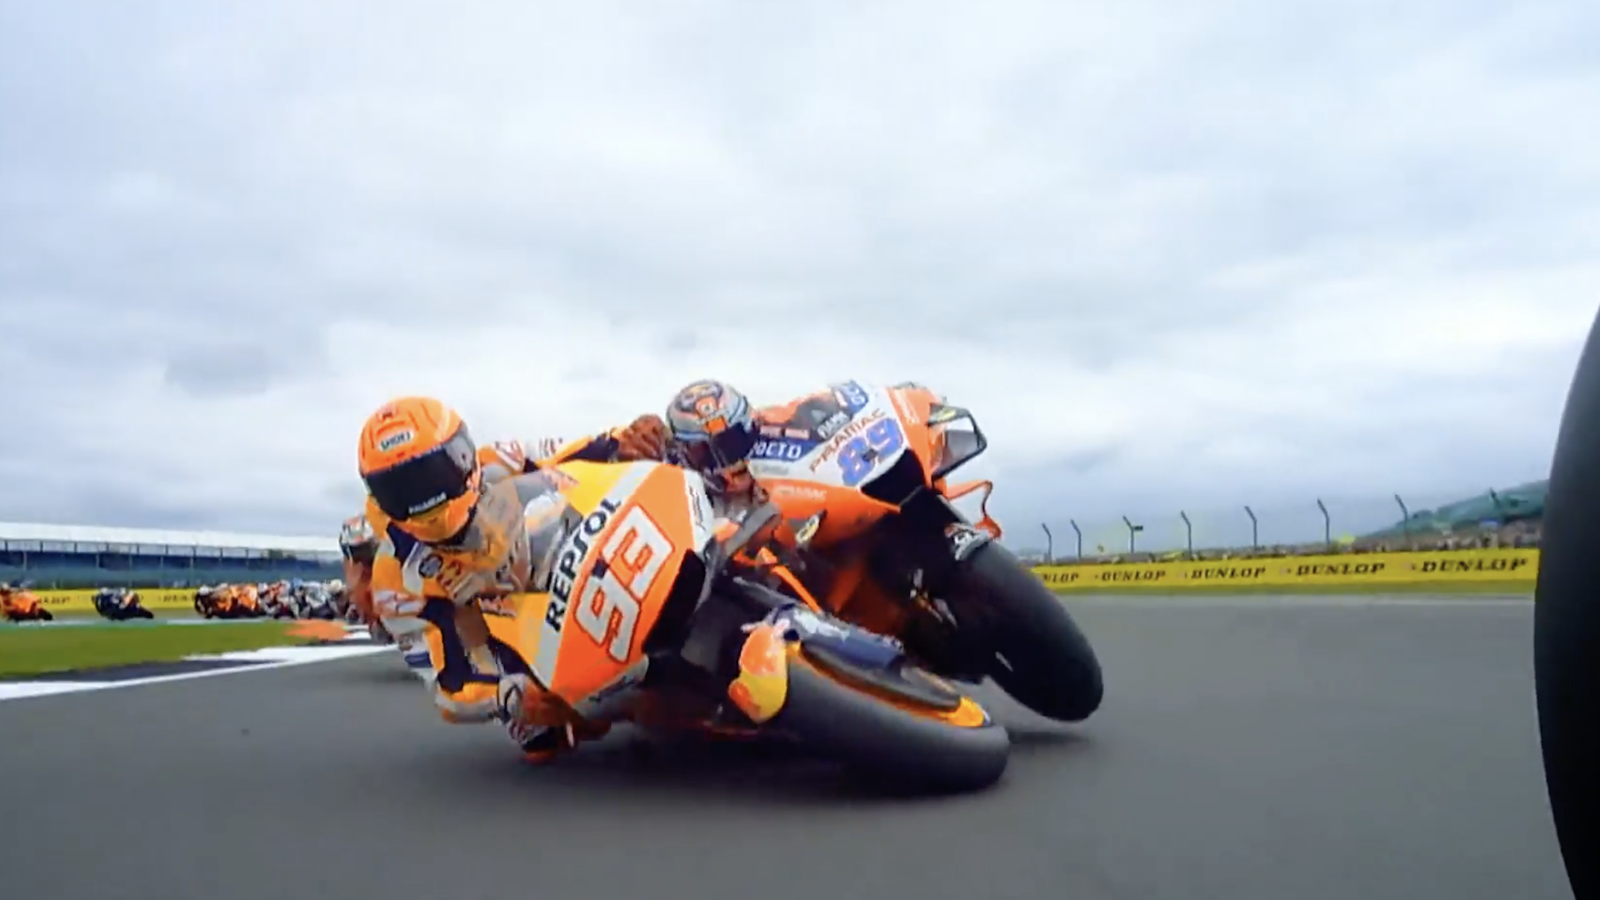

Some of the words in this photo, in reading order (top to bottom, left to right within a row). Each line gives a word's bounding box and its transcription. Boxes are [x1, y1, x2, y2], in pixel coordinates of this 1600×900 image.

[809, 408, 886, 472] PRAMAC
[836, 417, 904, 487] 89
[544, 498, 623, 632] REPSOL
[574, 504, 676, 663] 93
[1100, 570, 1167, 582] DUNLOP
[1190, 566, 1267, 580] DUNLOP
[1295, 562, 1386, 576] DUNLOP
[1421, 556, 1528, 573] DUNLOP
